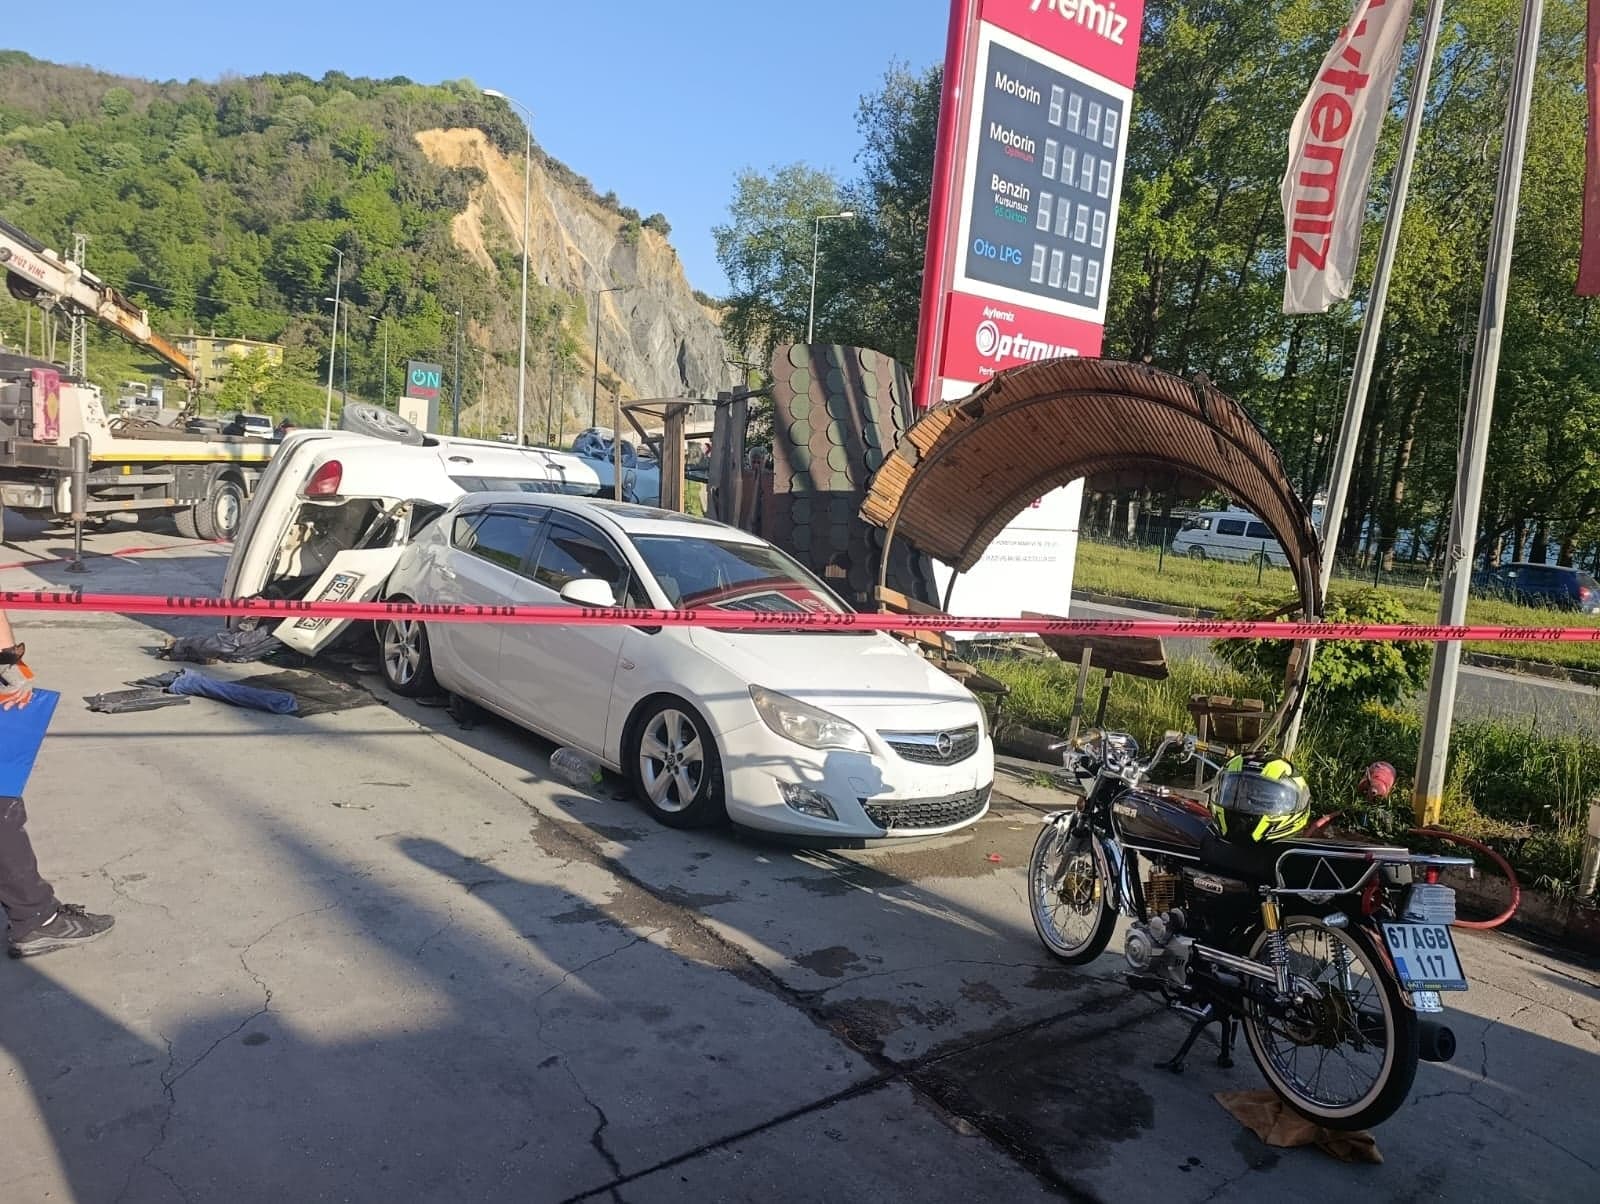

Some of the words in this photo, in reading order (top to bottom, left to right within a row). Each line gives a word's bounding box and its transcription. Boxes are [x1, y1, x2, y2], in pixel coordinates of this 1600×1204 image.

[995, 71, 1041, 105] Motorin
[990, 121, 1036, 154] Motorin
[991, 173, 1031, 202] Benzin
[973, 238, 997, 259] Oto
[999, 244, 1023, 265] LPG
[982, 305, 1016, 322] Aytemiz
[1387, 926, 1408, 949] 67
[1412, 927, 1449, 949] AGB
[1416, 955, 1446, 978] 117
